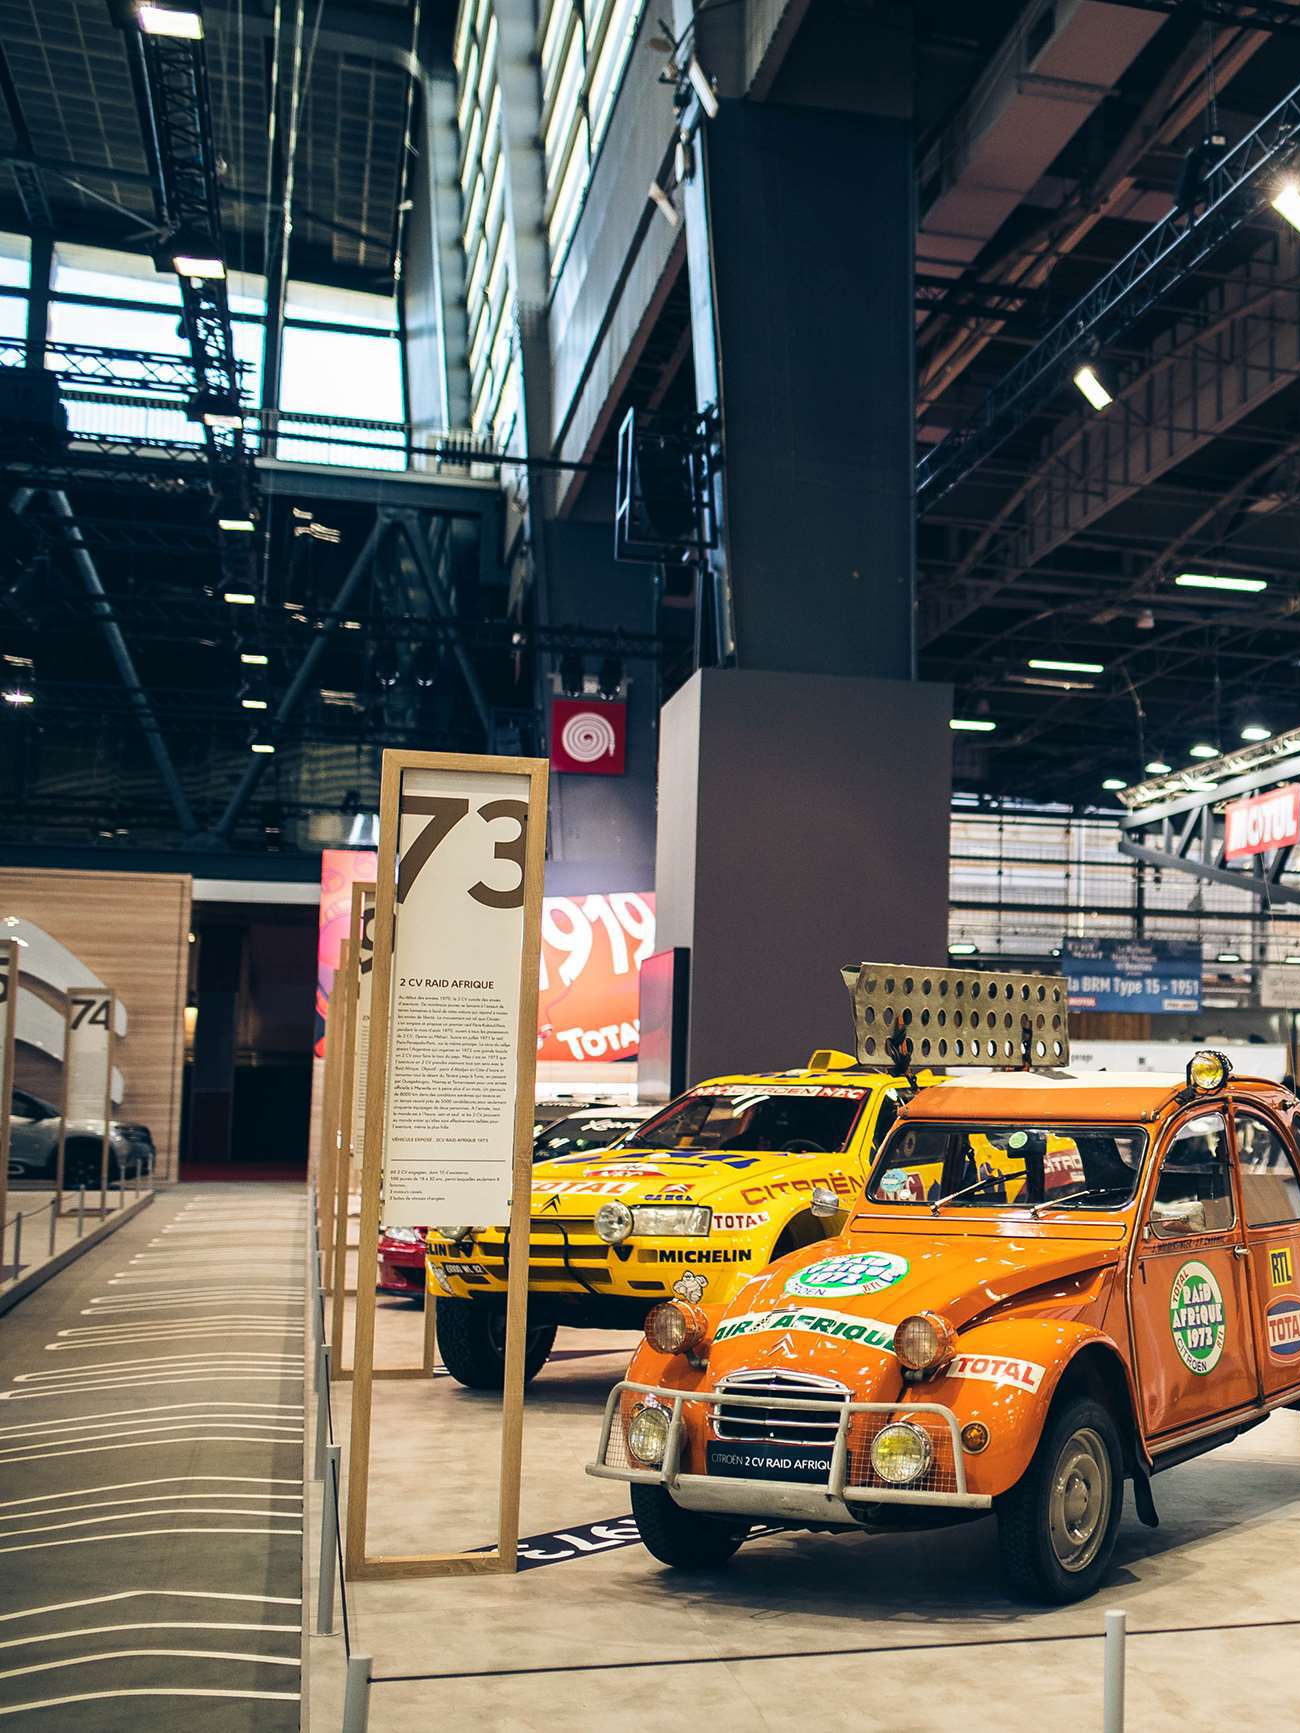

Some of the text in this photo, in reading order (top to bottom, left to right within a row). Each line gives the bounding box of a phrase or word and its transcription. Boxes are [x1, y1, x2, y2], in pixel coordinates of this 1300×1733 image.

[1230, 794, 1297, 852] MOTUL
[397, 796, 528, 909] 73
[400, 978, 494, 990] 2 CV RAID AFRIQUE
[1082, 976, 1110, 992] BRM
[1113, 977, 1142, 997] Type
[1144, 978, 1160, 995] 15
[1170, 979, 1199, 996] 1951
[71, 998, 110, 1030] 74
[556, 1019, 641, 1060] TOTA
[740, 1171, 865, 1206] CITROËN
[714, 1214, 768, 1229] TOTAL
[659, 1249, 752, 1263] MICHELIN
[1270, 1251, 1292, 1284] RTL
[1173, 1269, 1189, 1303] TOTAL
[712, 1320, 754, 1342] AIR
[1186, 1326, 1214, 1349] 1973
[958, 1357, 1036, 1387] TOTAL
[711, 1453, 743, 1465] CITROËN
[745, 1456, 751, 1467] 2
[751, 1457, 765, 1467] CV
[766, 1458, 792, 1469] RAID
